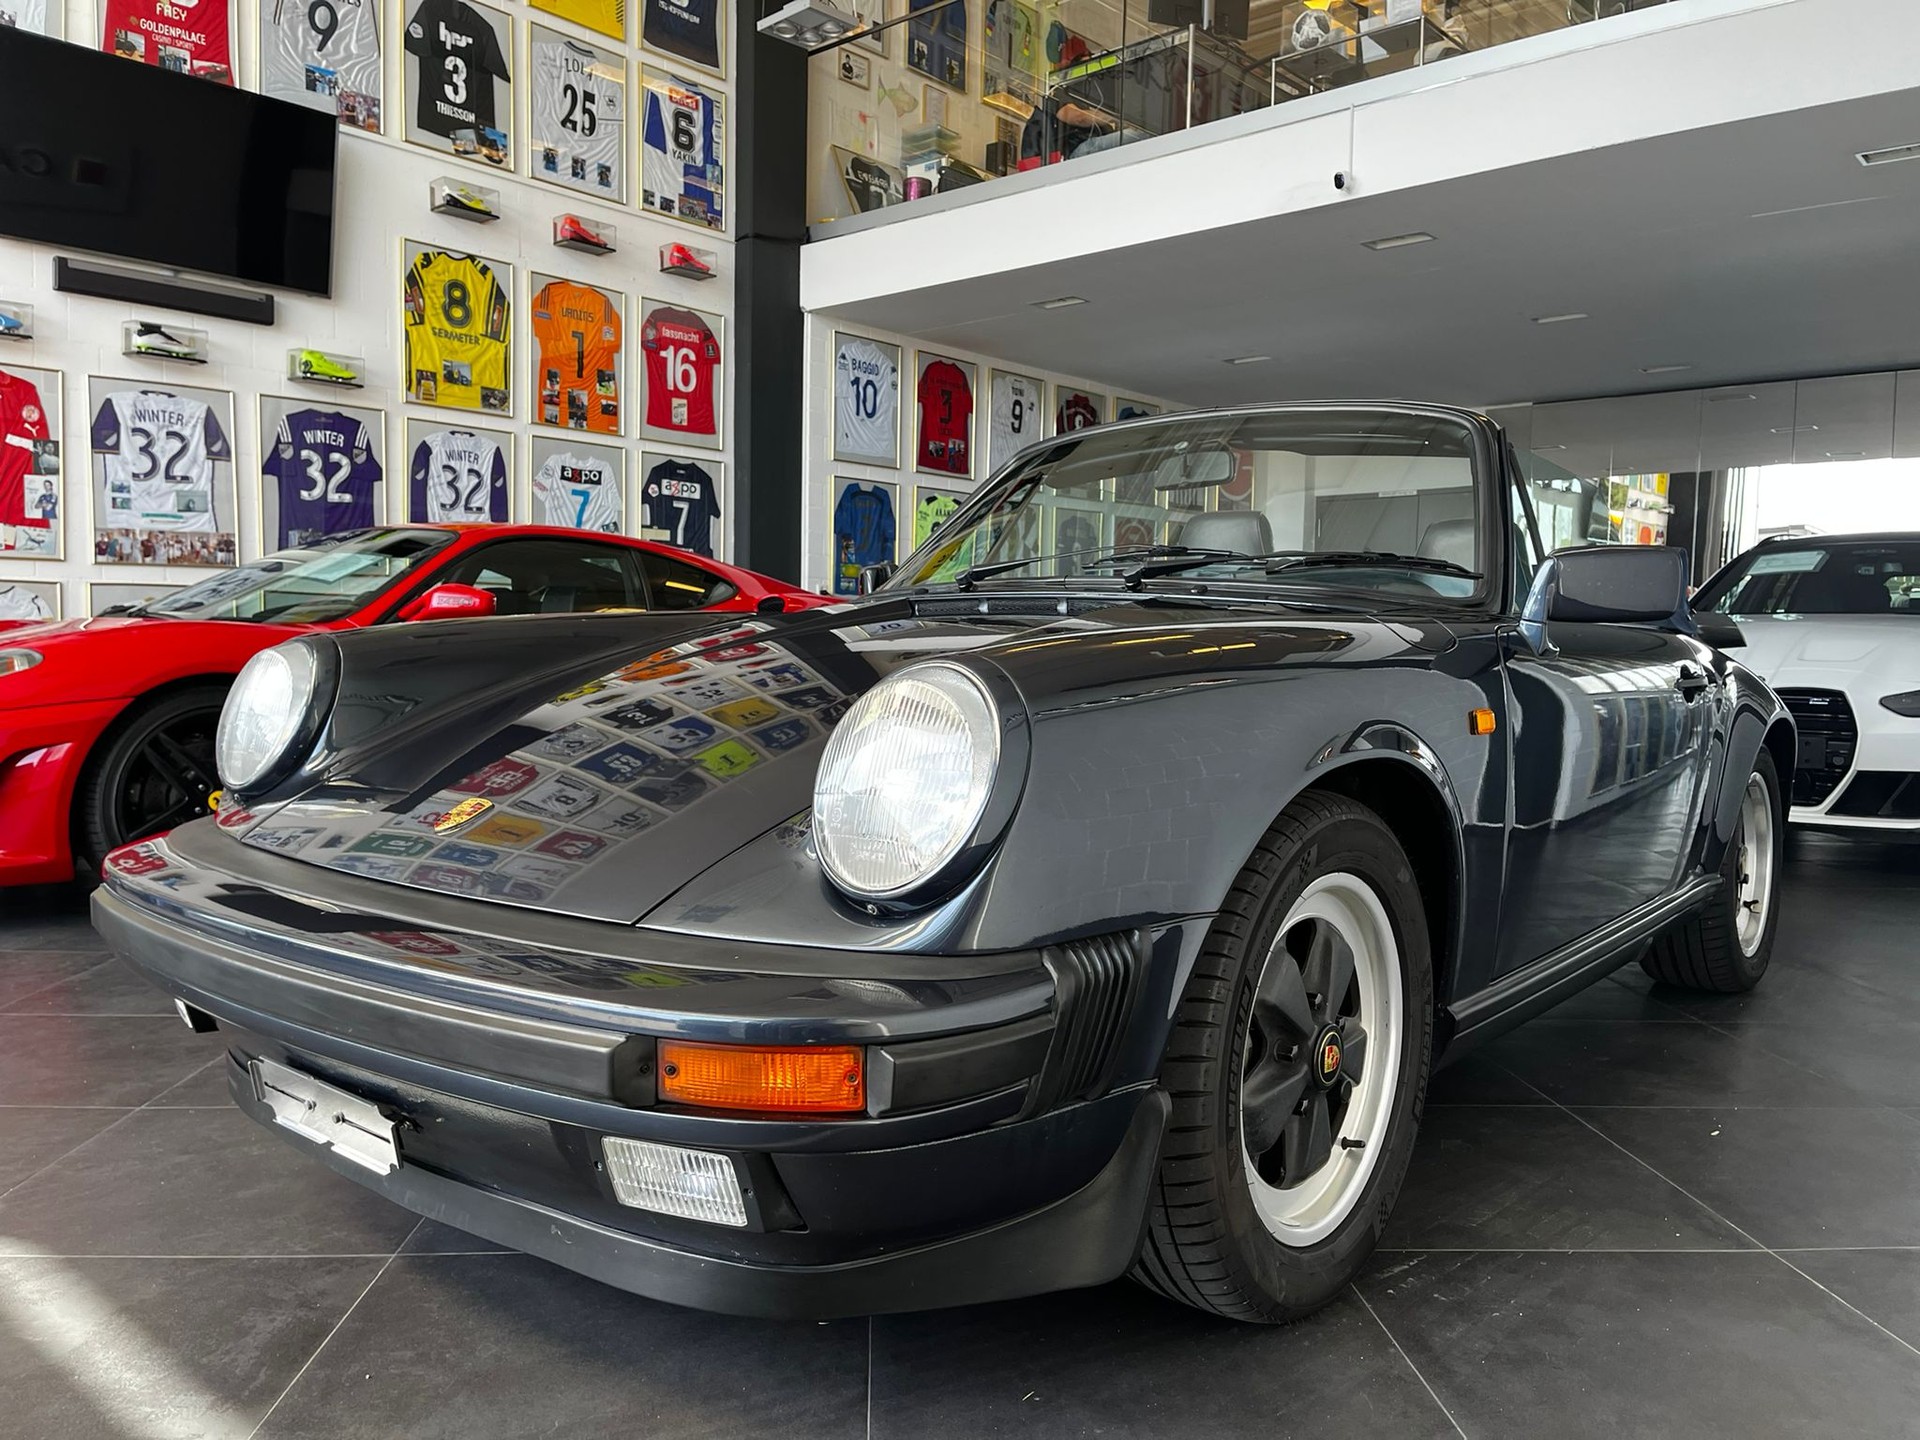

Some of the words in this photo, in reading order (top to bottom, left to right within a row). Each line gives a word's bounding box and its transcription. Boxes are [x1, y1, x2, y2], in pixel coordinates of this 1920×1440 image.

[140, 18, 206, 45] GOLDENPALACE
[156, 2, 187, 22] FREY
[308, 0, 338, 52] 9
[444, 55, 467, 104] 3
[560, 84, 597, 137] 25
[673, 107, 696, 154] 6
[672, 148, 697, 164] YAKIN
[442, 279, 472, 329] 8
[571, 330, 584, 379] 1
[659, 345, 697, 393] 16
[852, 358, 879, 376] BAGGIO
[135, 408, 185, 427] WINTER
[850, 376, 877, 419] 10
[1011, 399, 1023, 434] 9
[131, 427, 193, 483] 32
[303, 429, 345, 447] WINTER
[445, 450, 480, 465] WINTER
[300, 449, 353, 503] 32
[440, 465, 485, 514] 32
[571, 489, 590, 528] 7
[673, 501, 690, 545] 7
[1227, 983, 1252, 1128] MICHELIN
[1413, 1004, 1432, 1119] MICHELIN
